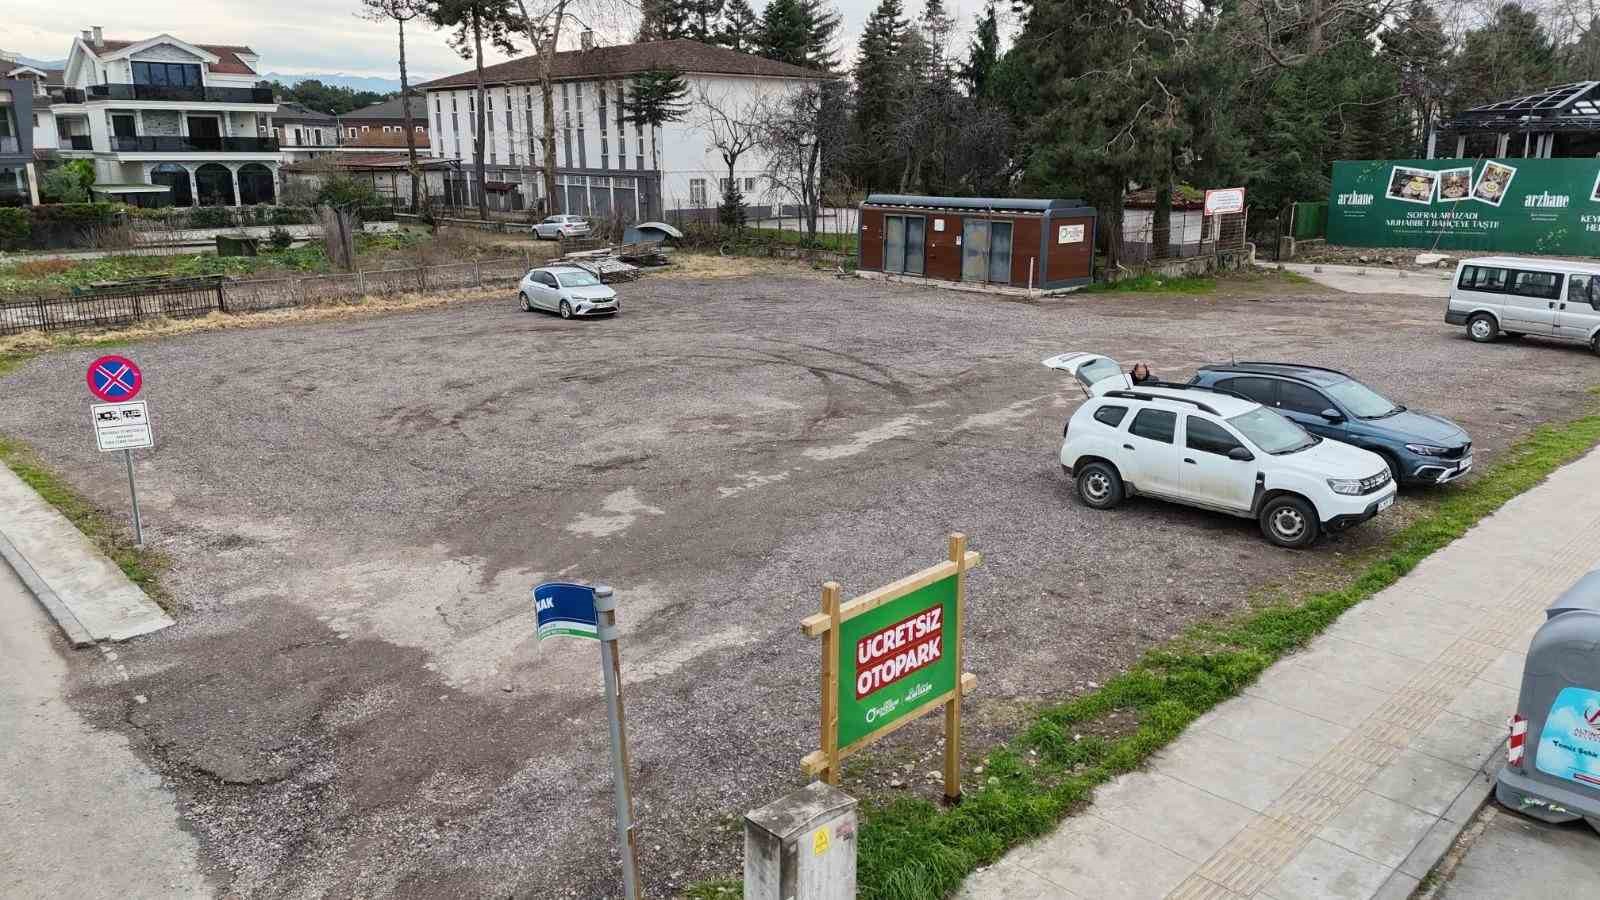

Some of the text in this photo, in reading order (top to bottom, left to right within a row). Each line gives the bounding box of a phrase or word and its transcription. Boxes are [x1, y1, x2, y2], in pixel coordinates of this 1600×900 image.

[1338, 190, 1373, 205] arzhane
[1524, 190, 1569, 207] arzhane
[858, 608, 941, 663] ÜCRETSİZ
[858, 637, 940, 694] OTOPARK
